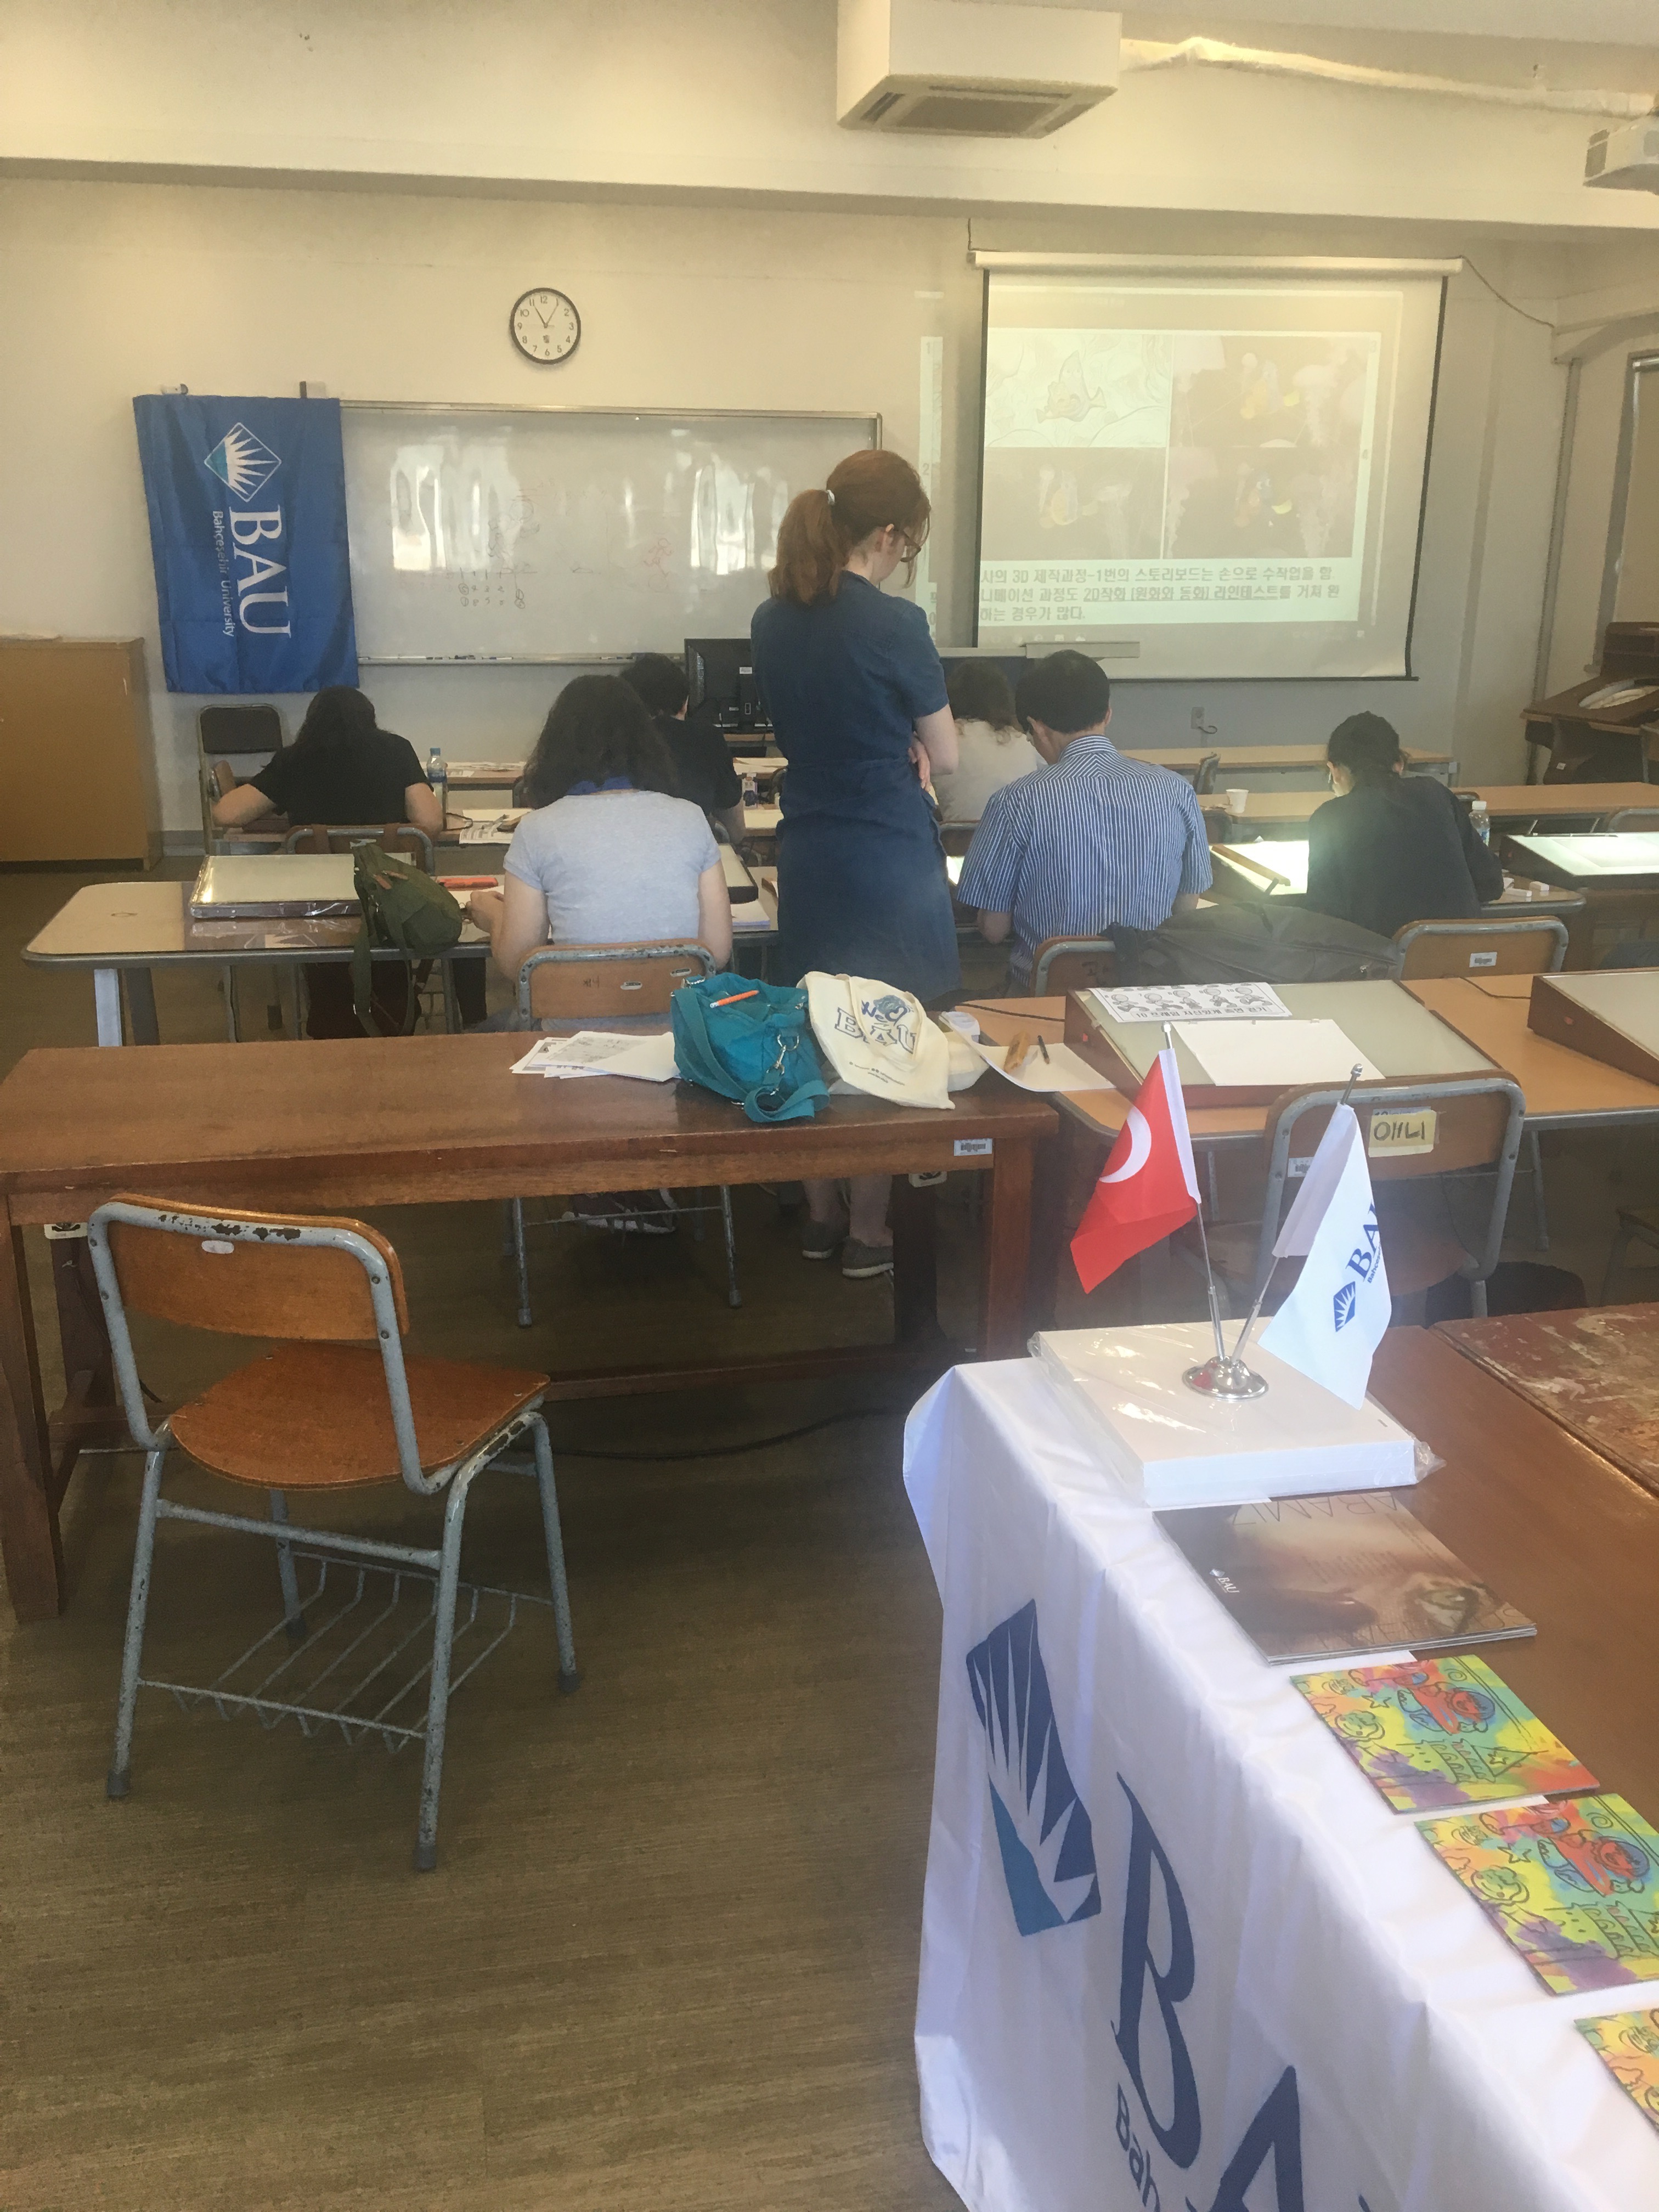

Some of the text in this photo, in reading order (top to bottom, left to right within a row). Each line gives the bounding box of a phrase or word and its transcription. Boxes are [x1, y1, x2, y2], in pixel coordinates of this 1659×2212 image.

[520, 309, 529, 317] 10
[564, 308, 569, 317] 2
[569, 322, 574, 330] 3
[557, 345, 562, 353] 5
[229, 505, 292, 639] BAU
[1013, 569, 1029, 583] 3D
[1135, 567, 1214, 582] 스토리보드는
[1220, 566, 1257, 582] 손으로
[1263, 566, 1314, 581] 수작업을
[1039, 587, 1079, 602] 과정도
[221, 579, 235, 637] University
[1012, 606, 1051, 621] 경우가
[834, 1007, 917, 1054] BAU
[1345, 1199, 1379, 1282] BA
[1218, 1577, 1240, 1593] BAU
